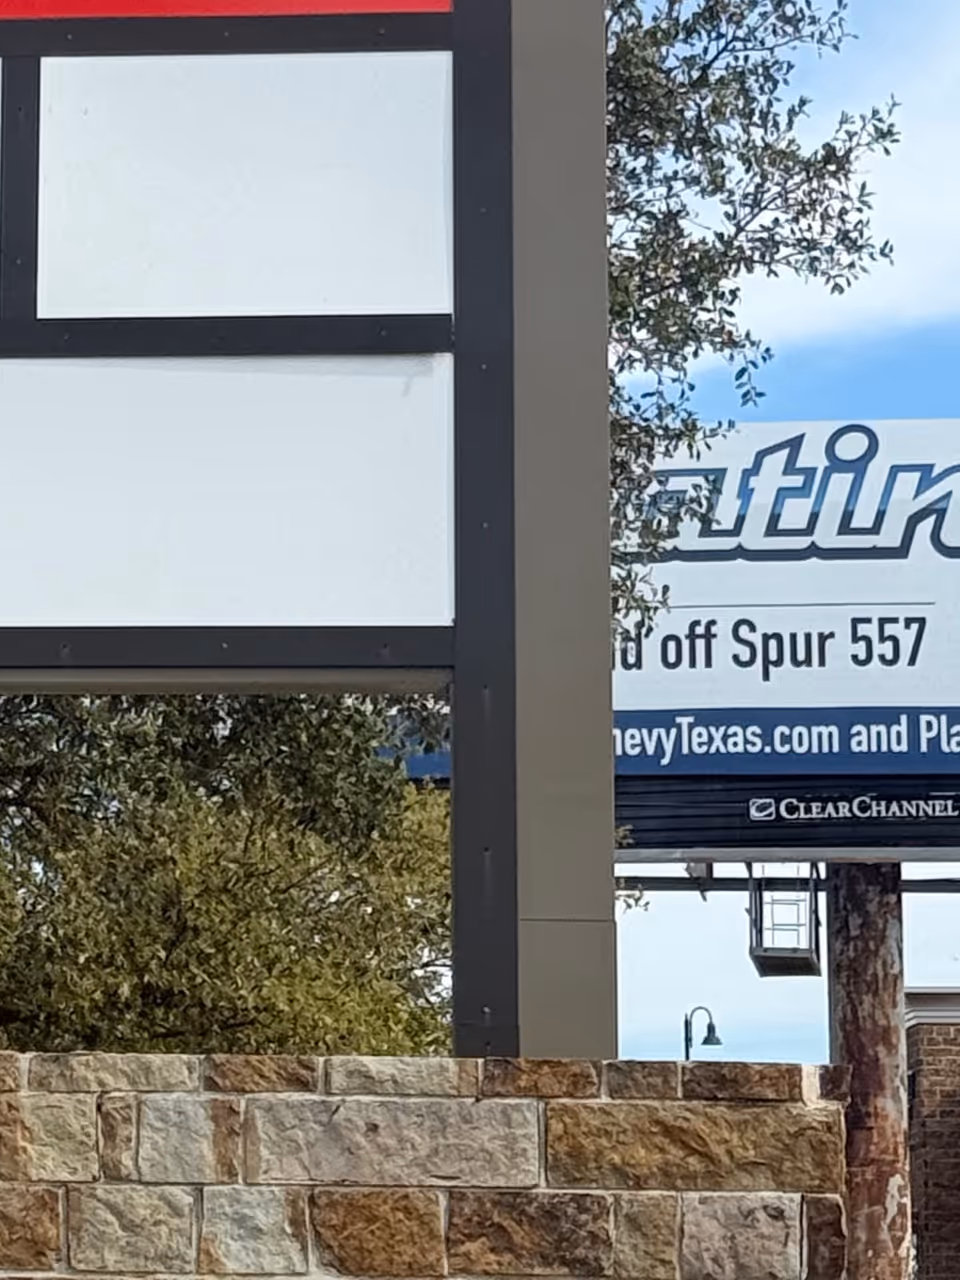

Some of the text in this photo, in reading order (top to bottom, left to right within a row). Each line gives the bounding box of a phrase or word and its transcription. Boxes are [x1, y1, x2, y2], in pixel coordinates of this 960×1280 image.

[660, 619, 718, 670] off
[731, 618, 836, 682] Spur
[850, 616, 927, 667] 557
[850, 714, 909, 753] and
